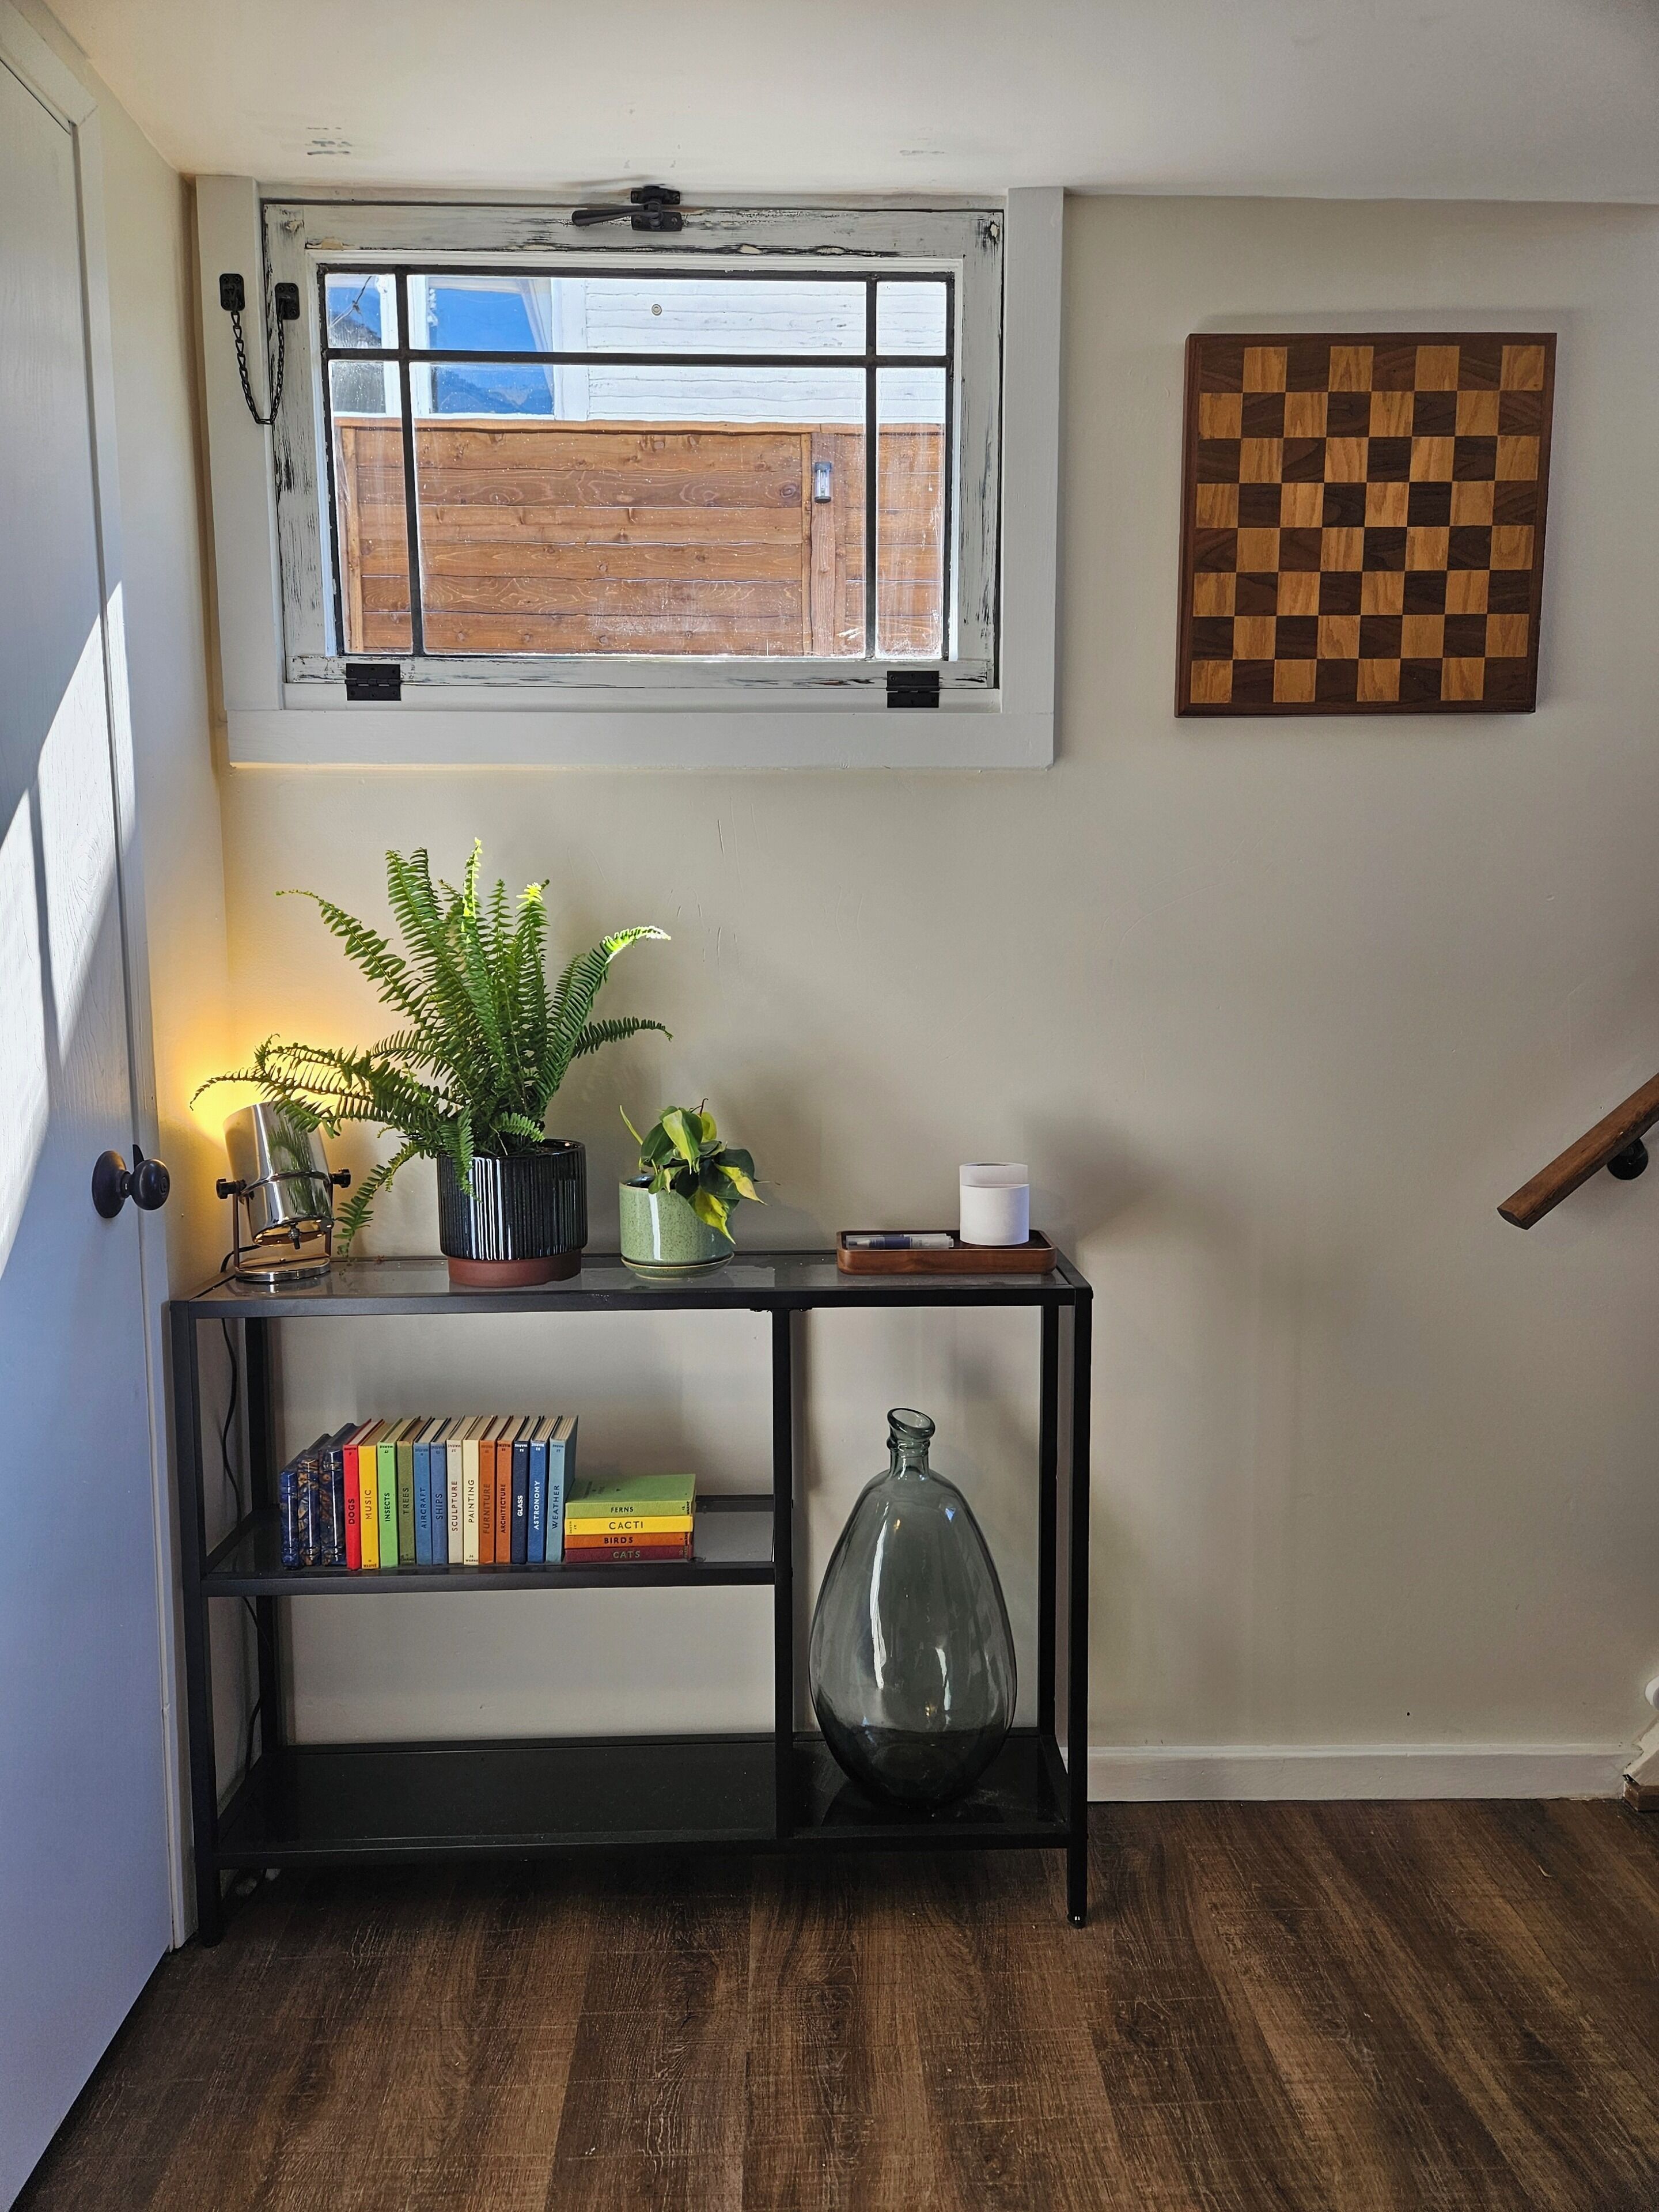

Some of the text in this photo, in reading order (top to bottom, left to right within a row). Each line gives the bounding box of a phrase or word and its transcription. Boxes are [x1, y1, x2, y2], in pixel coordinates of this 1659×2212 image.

[435, 1494, 444, 1520] SHIPS
[609, 1521, 643, 1530] CACTI
[613, 1551, 640, 1559] CATS
